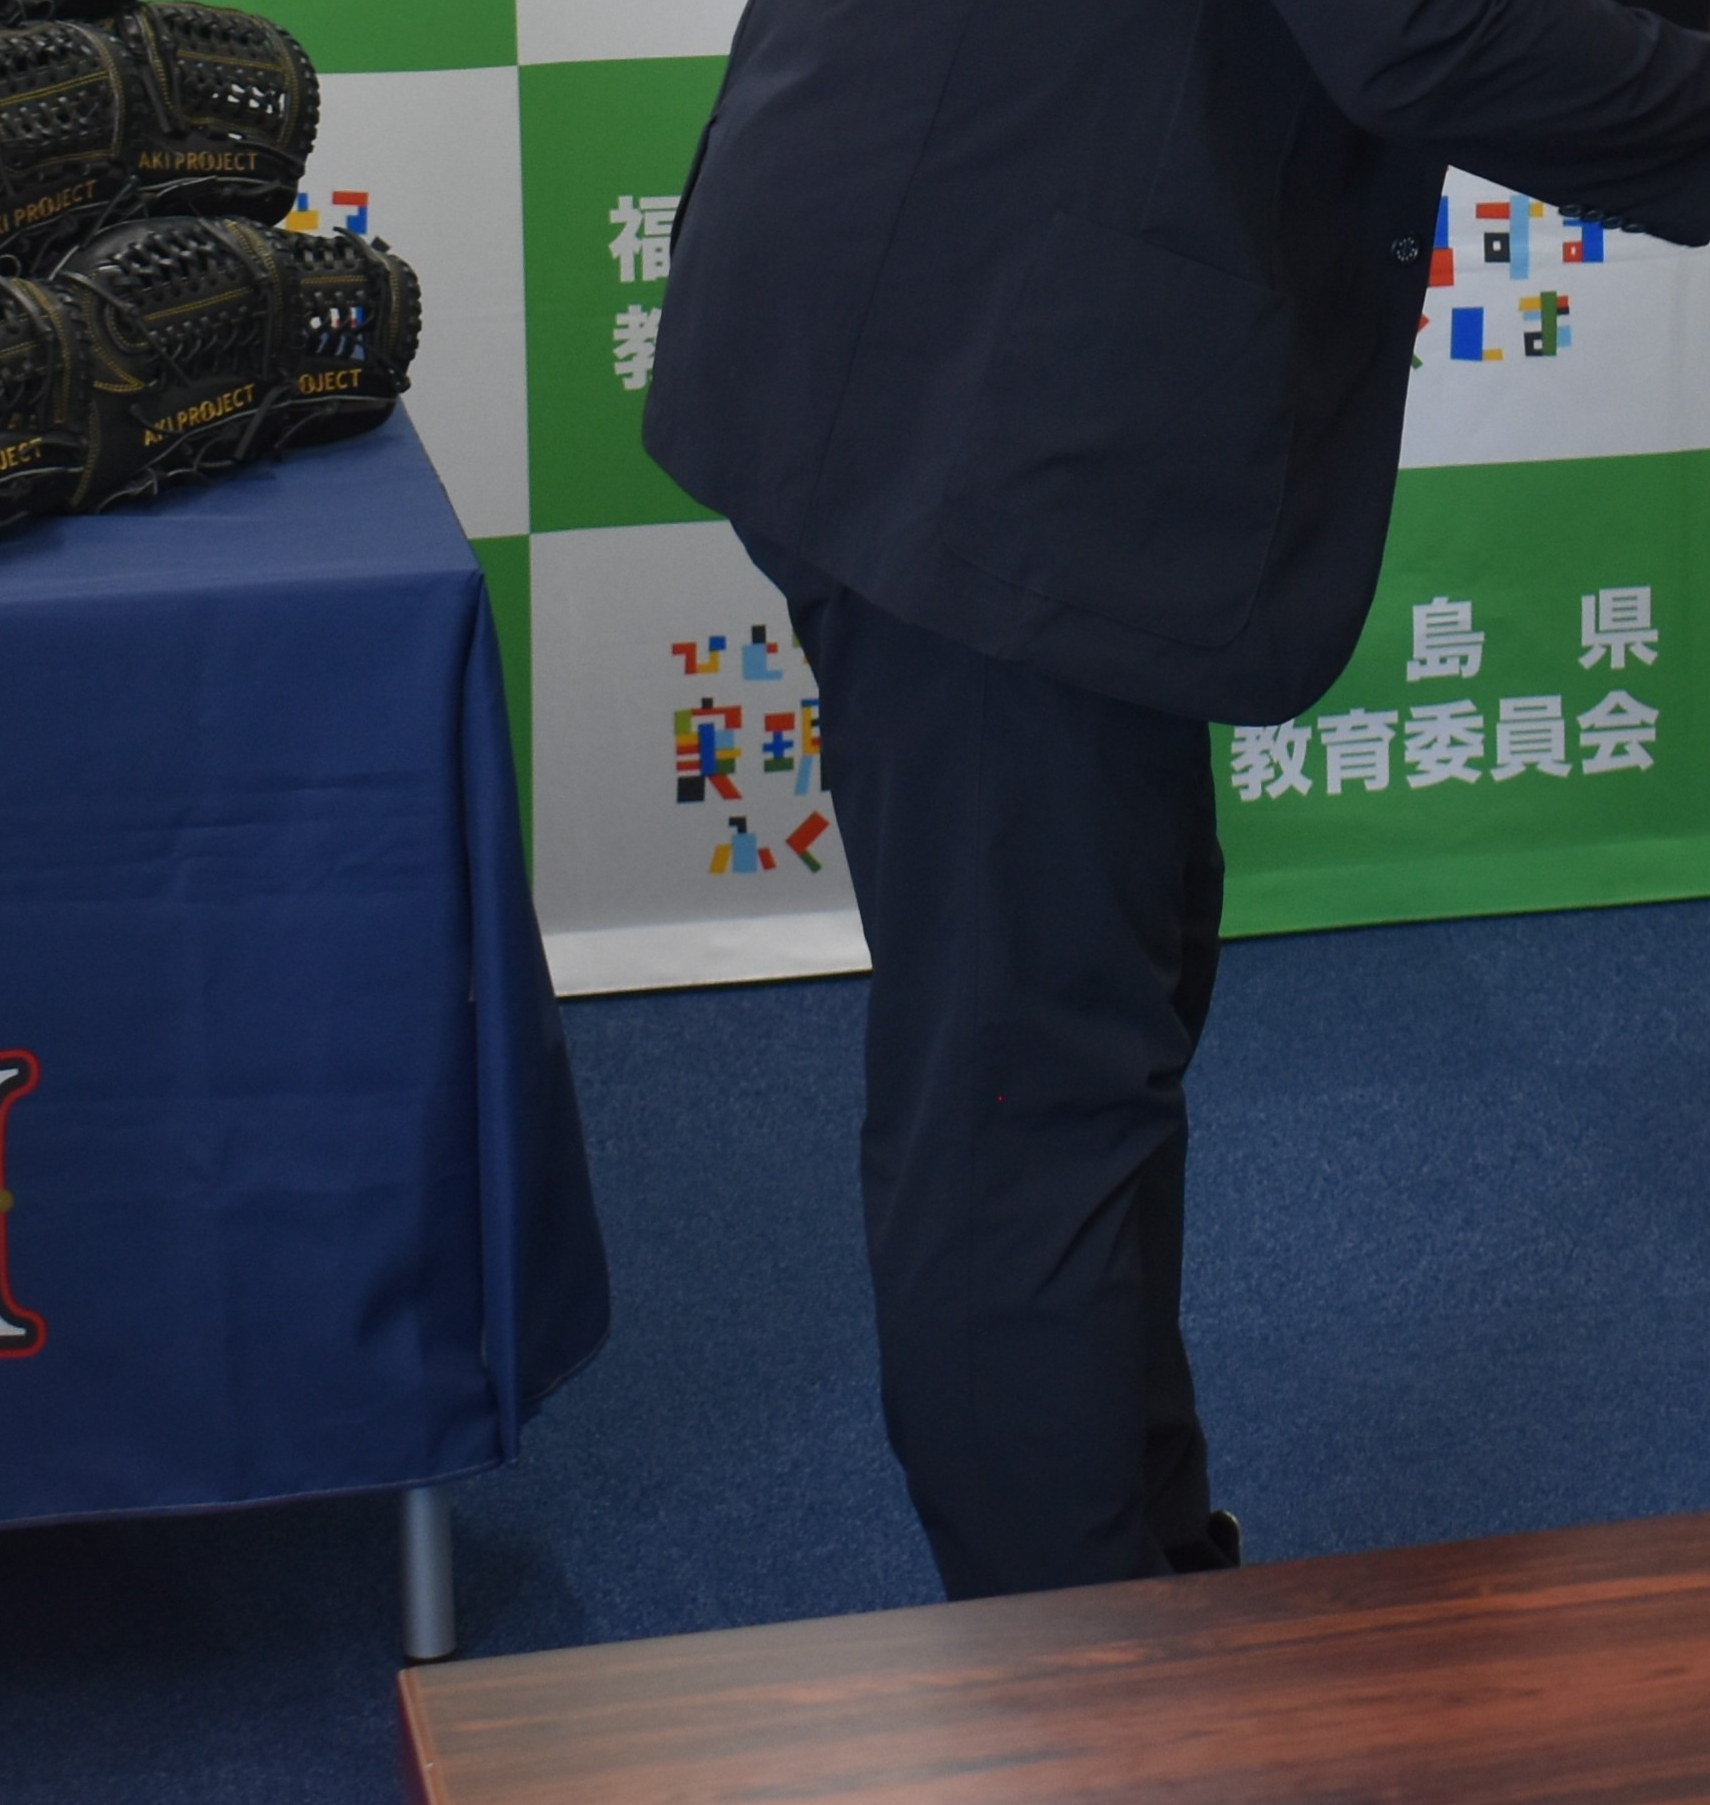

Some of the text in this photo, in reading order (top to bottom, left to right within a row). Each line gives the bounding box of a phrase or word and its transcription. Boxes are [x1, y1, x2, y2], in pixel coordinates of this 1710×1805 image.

[139, 151, 258, 171] AKI PROJECT
[14, 179, 98, 227] PROJECT
[298, 367, 363, 394] OJECT
[177, 383, 256, 431] PROJECT
[1407, 587, 1659, 682] 島県
[1231, 691, 1659, 801] 教育委員会
